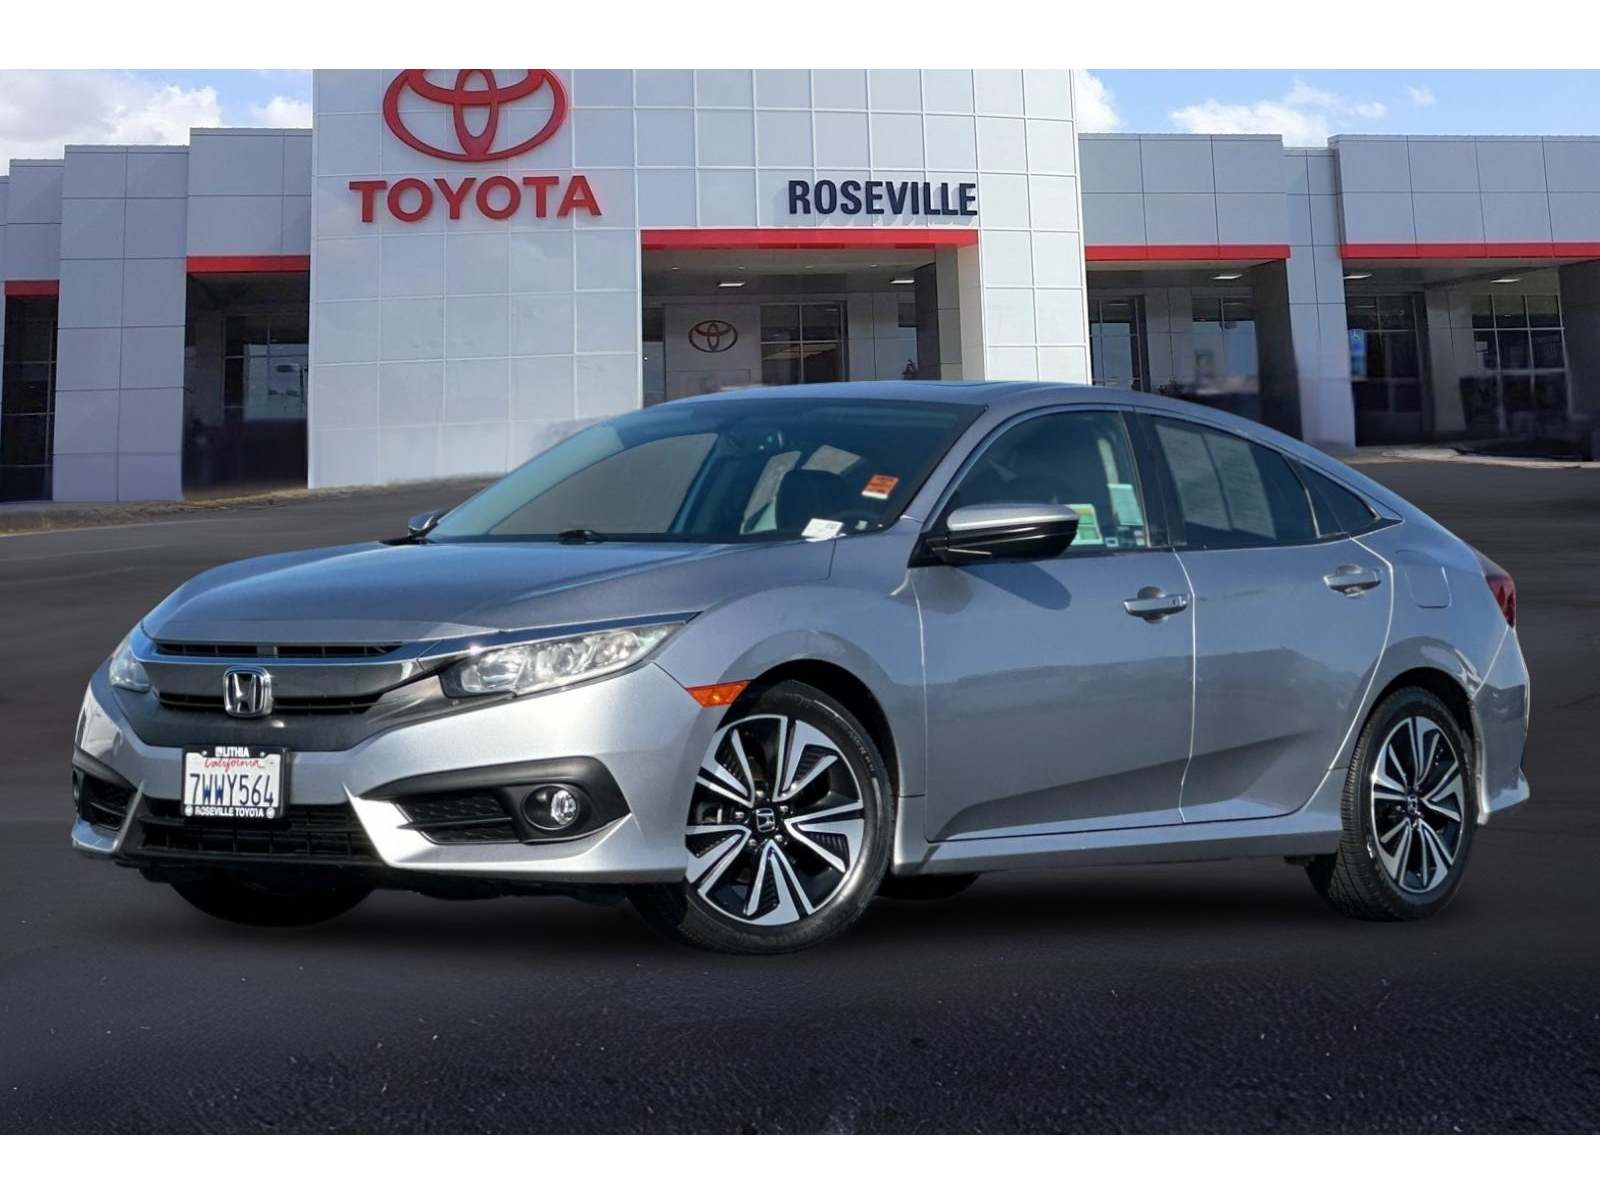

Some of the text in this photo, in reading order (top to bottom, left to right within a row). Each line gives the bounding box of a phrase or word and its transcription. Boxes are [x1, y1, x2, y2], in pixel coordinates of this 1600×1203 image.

[350, 175, 602, 223] TOYOTA
[788, 180, 979, 216] ROSEVILLE
[204, 758, 264, 772] California
[190, 773, 274, 806] 7WWY564
[194, 806, 264, 817] ROSEVILLE TOYOTA
